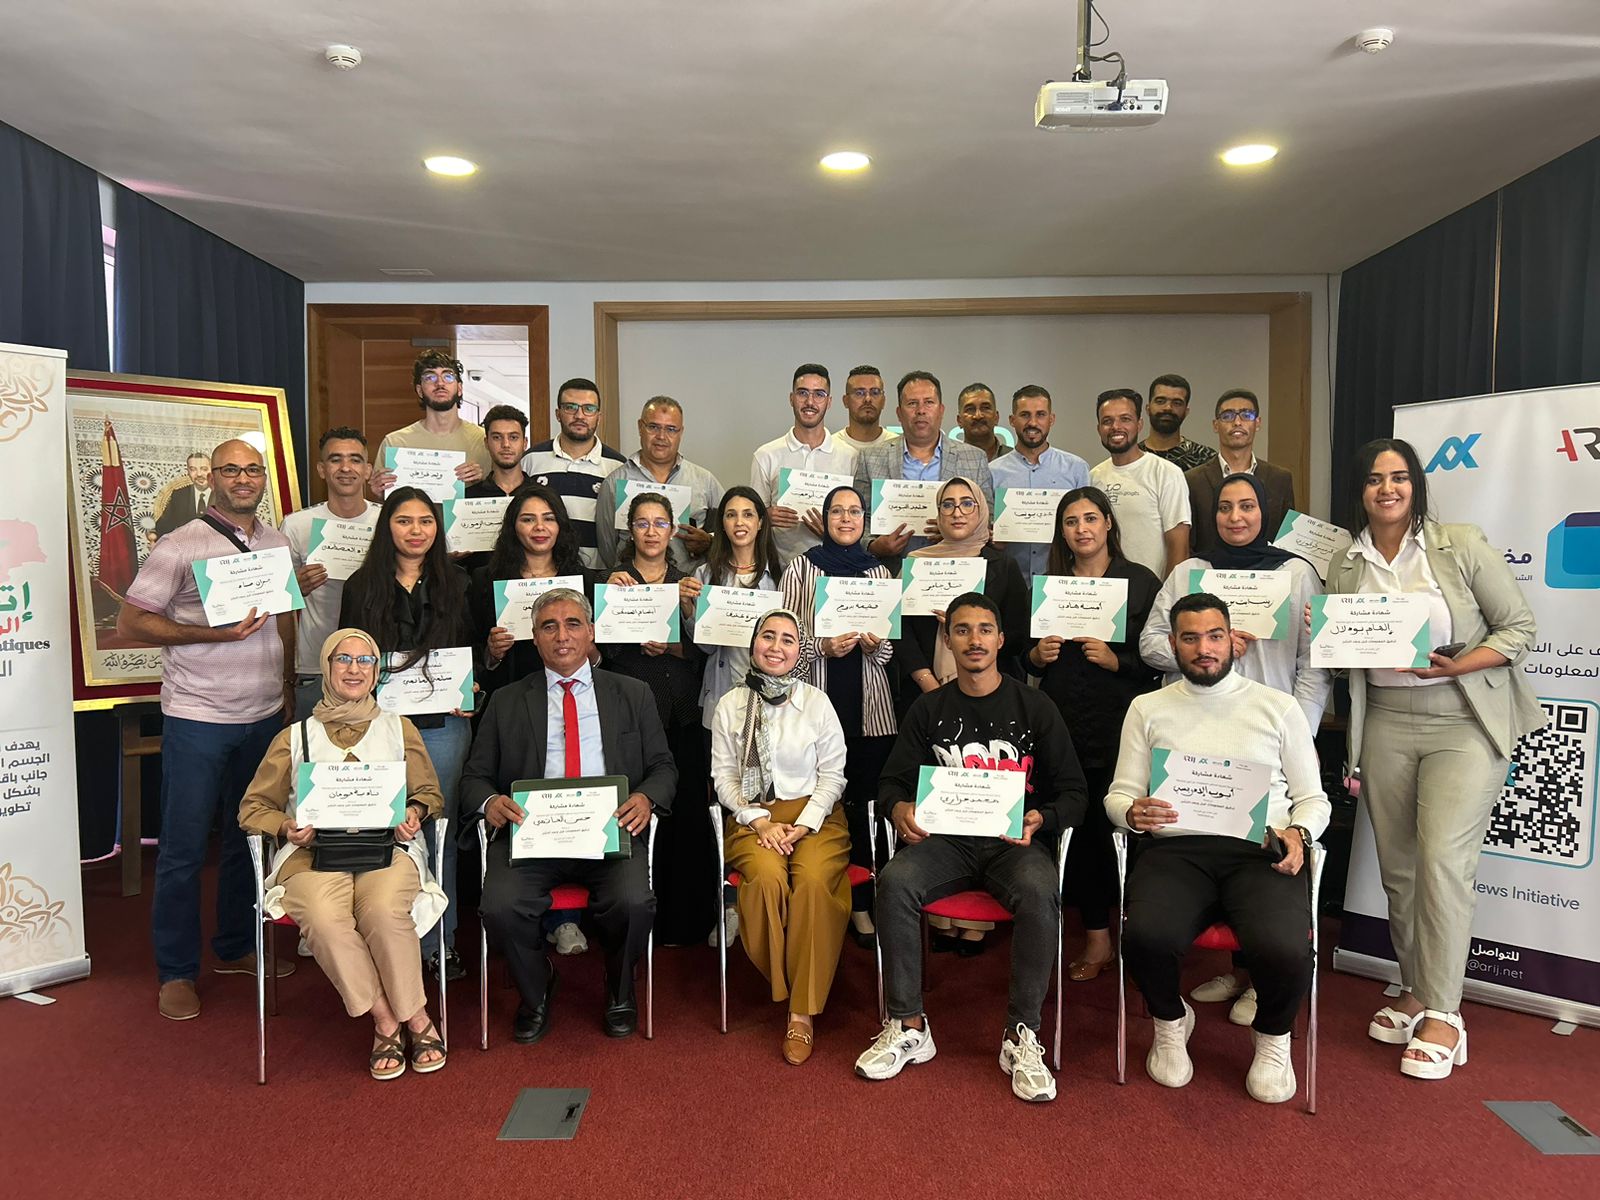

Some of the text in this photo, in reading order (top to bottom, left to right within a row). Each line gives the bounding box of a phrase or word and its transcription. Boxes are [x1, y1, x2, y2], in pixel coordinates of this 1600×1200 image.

[0, 639, 50, 654] tiques
[1557, 643, 1584, 657] على
[5, 741, 40, 752] يهدف
[8, 753, 50, 769] الجسم
[21, 769, 48, 783] جانب
[3, 785, 41, 799] بشكل
[1512, 886, 1580, 910] Initiative
[1471, 944, 1520, 962] للتواصل
